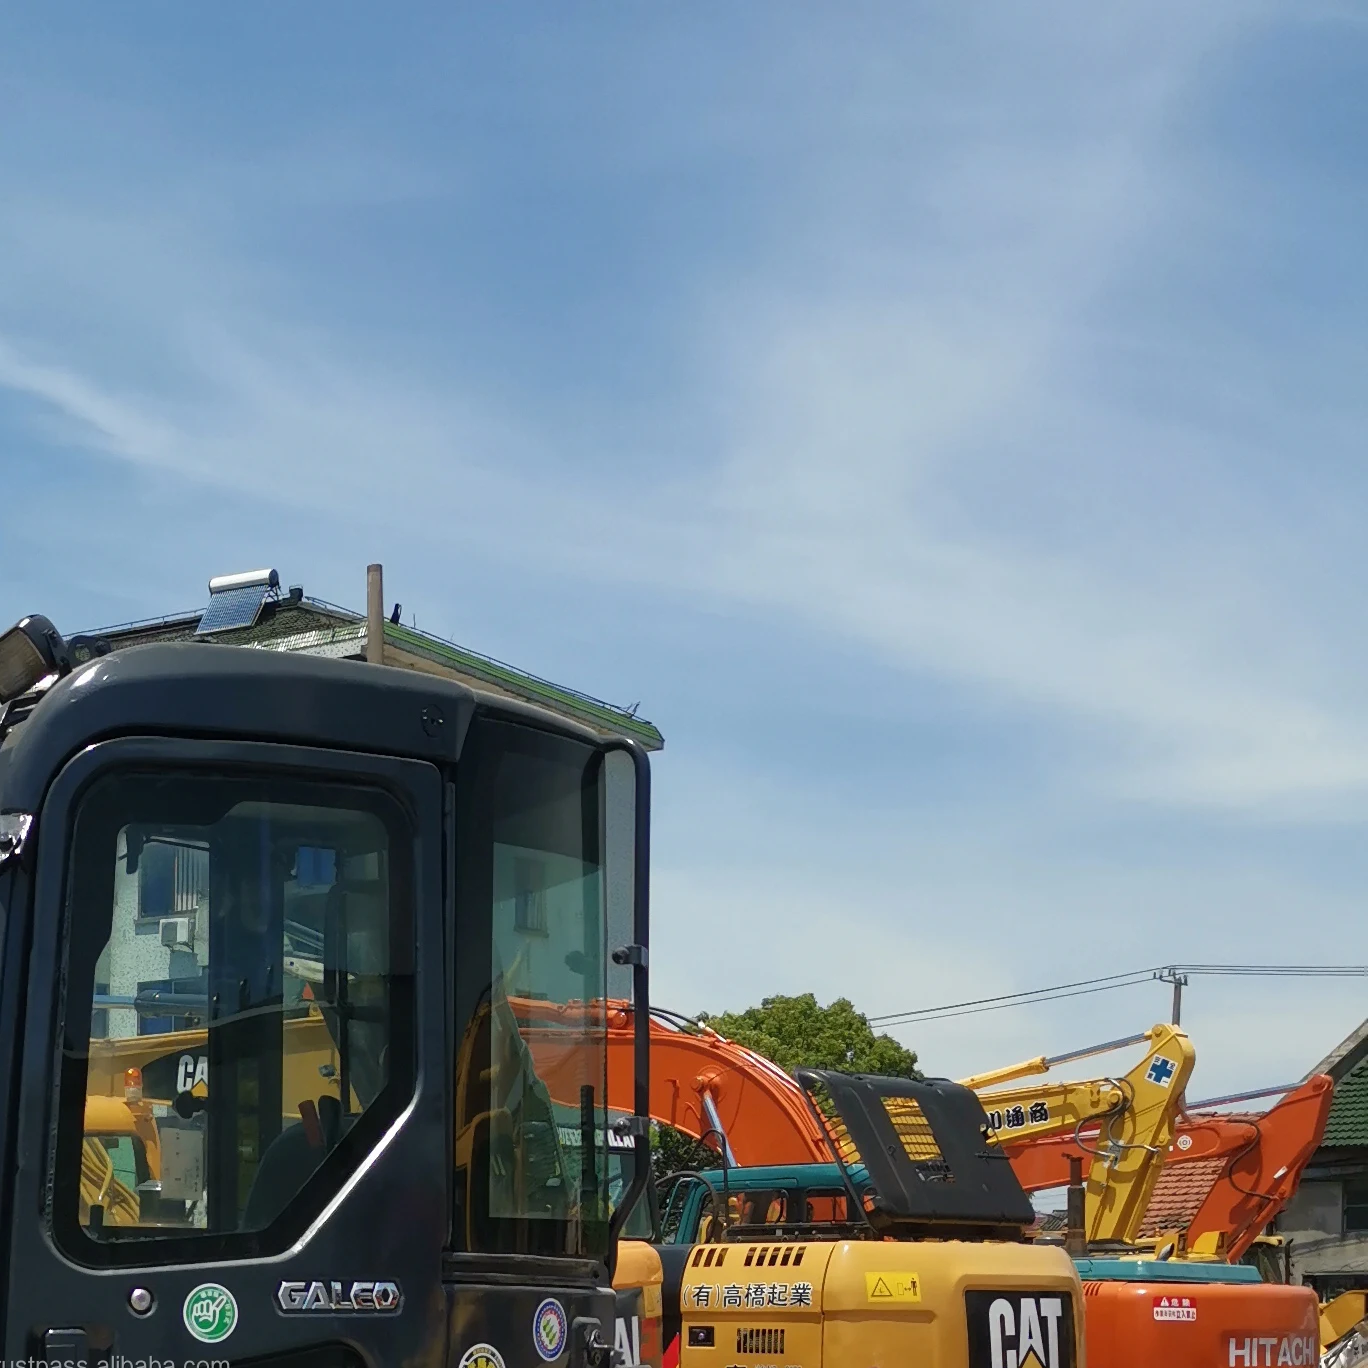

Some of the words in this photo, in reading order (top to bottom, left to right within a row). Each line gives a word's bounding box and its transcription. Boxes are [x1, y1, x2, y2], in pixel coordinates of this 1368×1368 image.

[177, 1055, 209, 1094] CA
[278, 1281, 400, 1309] GALEO
[1228, 1337, 1315, 1368] HITACHI
